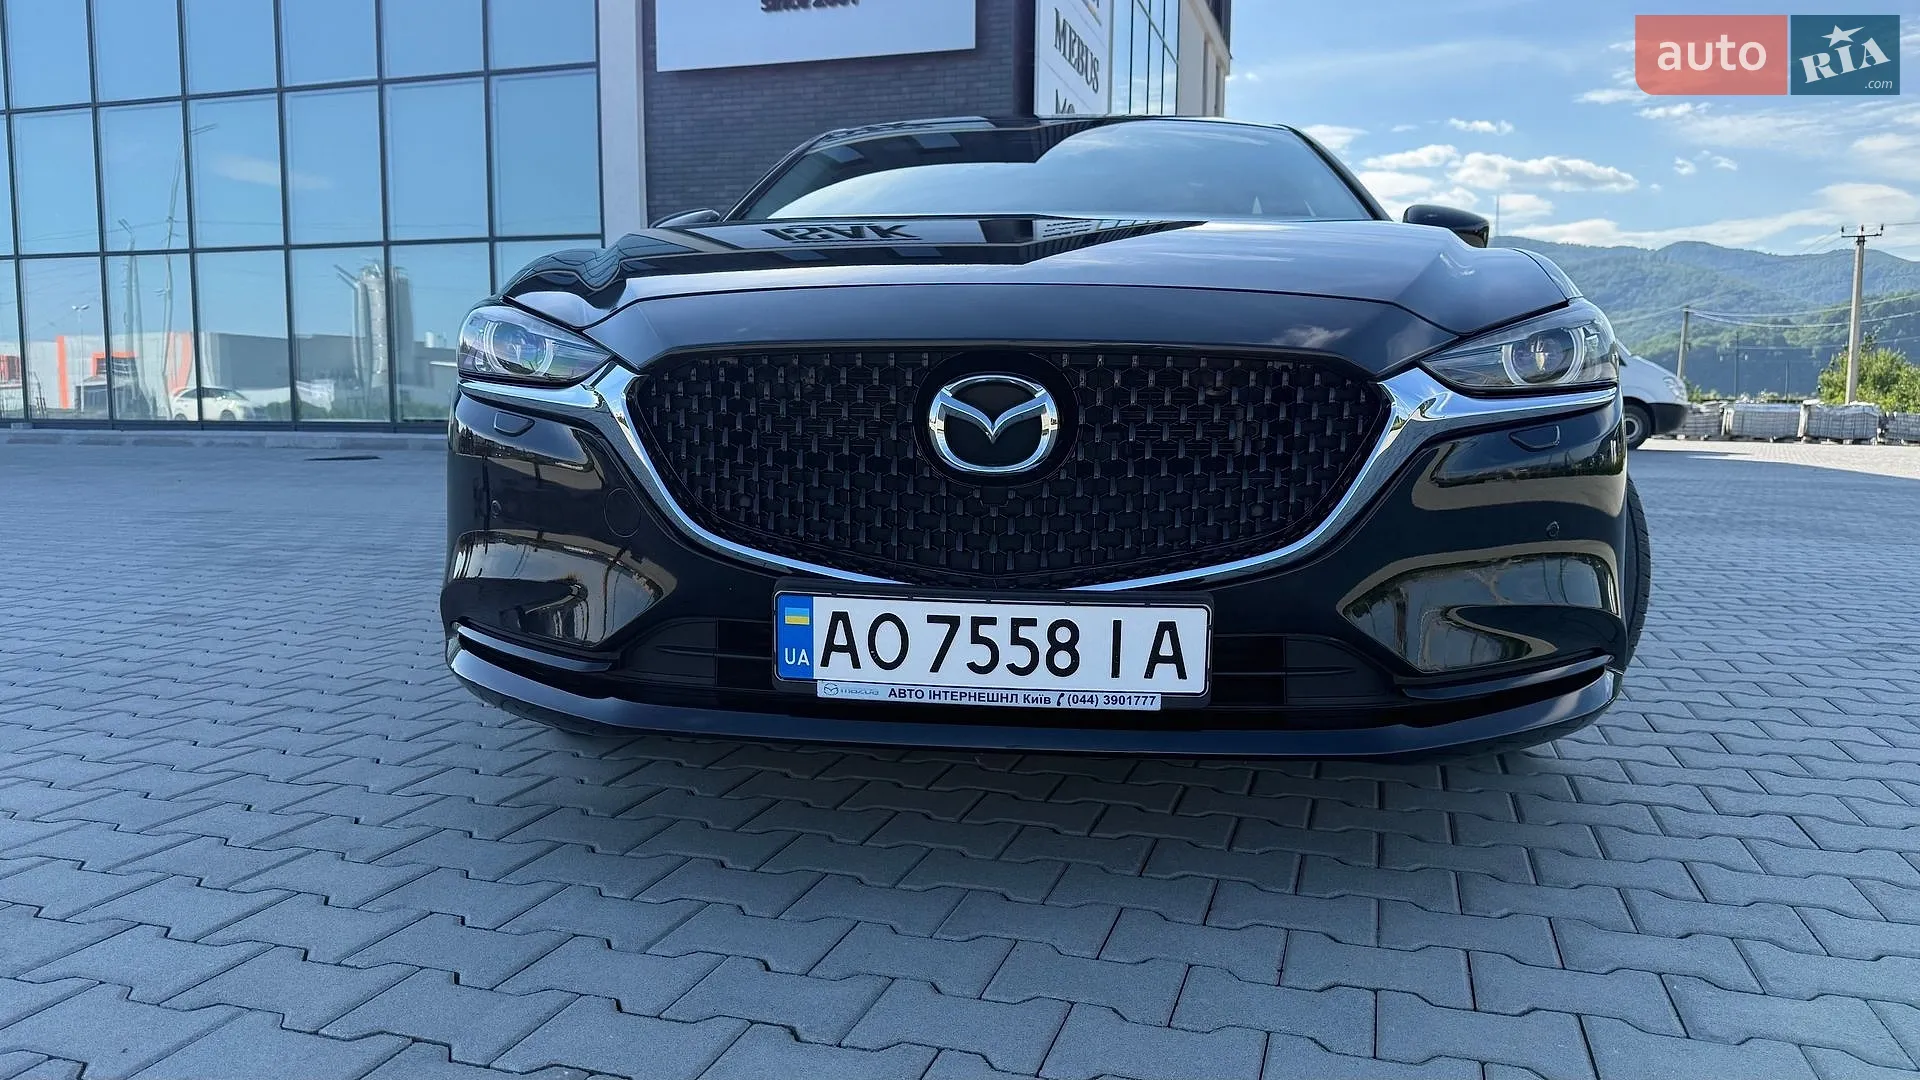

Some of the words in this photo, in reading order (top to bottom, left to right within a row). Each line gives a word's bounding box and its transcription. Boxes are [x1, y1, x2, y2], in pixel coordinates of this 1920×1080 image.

[1054, 7, 1099, 94] MEBUS
[784, 648, 810, 666] UA
[820, 611, 910, 671] AO
[926, 614, 1081, 678] 7558
[1110, 619, 1188, 681] IA
[888, 688, 925, 700] АВТО
[928, 690, 1019, 705] ІНТЕРНЕШНЛ
[1023, 693, 1052, 705] Київ
[1067, 694, 1099, 708] (044)
[1103, 695, 1156, 706] 3901777
